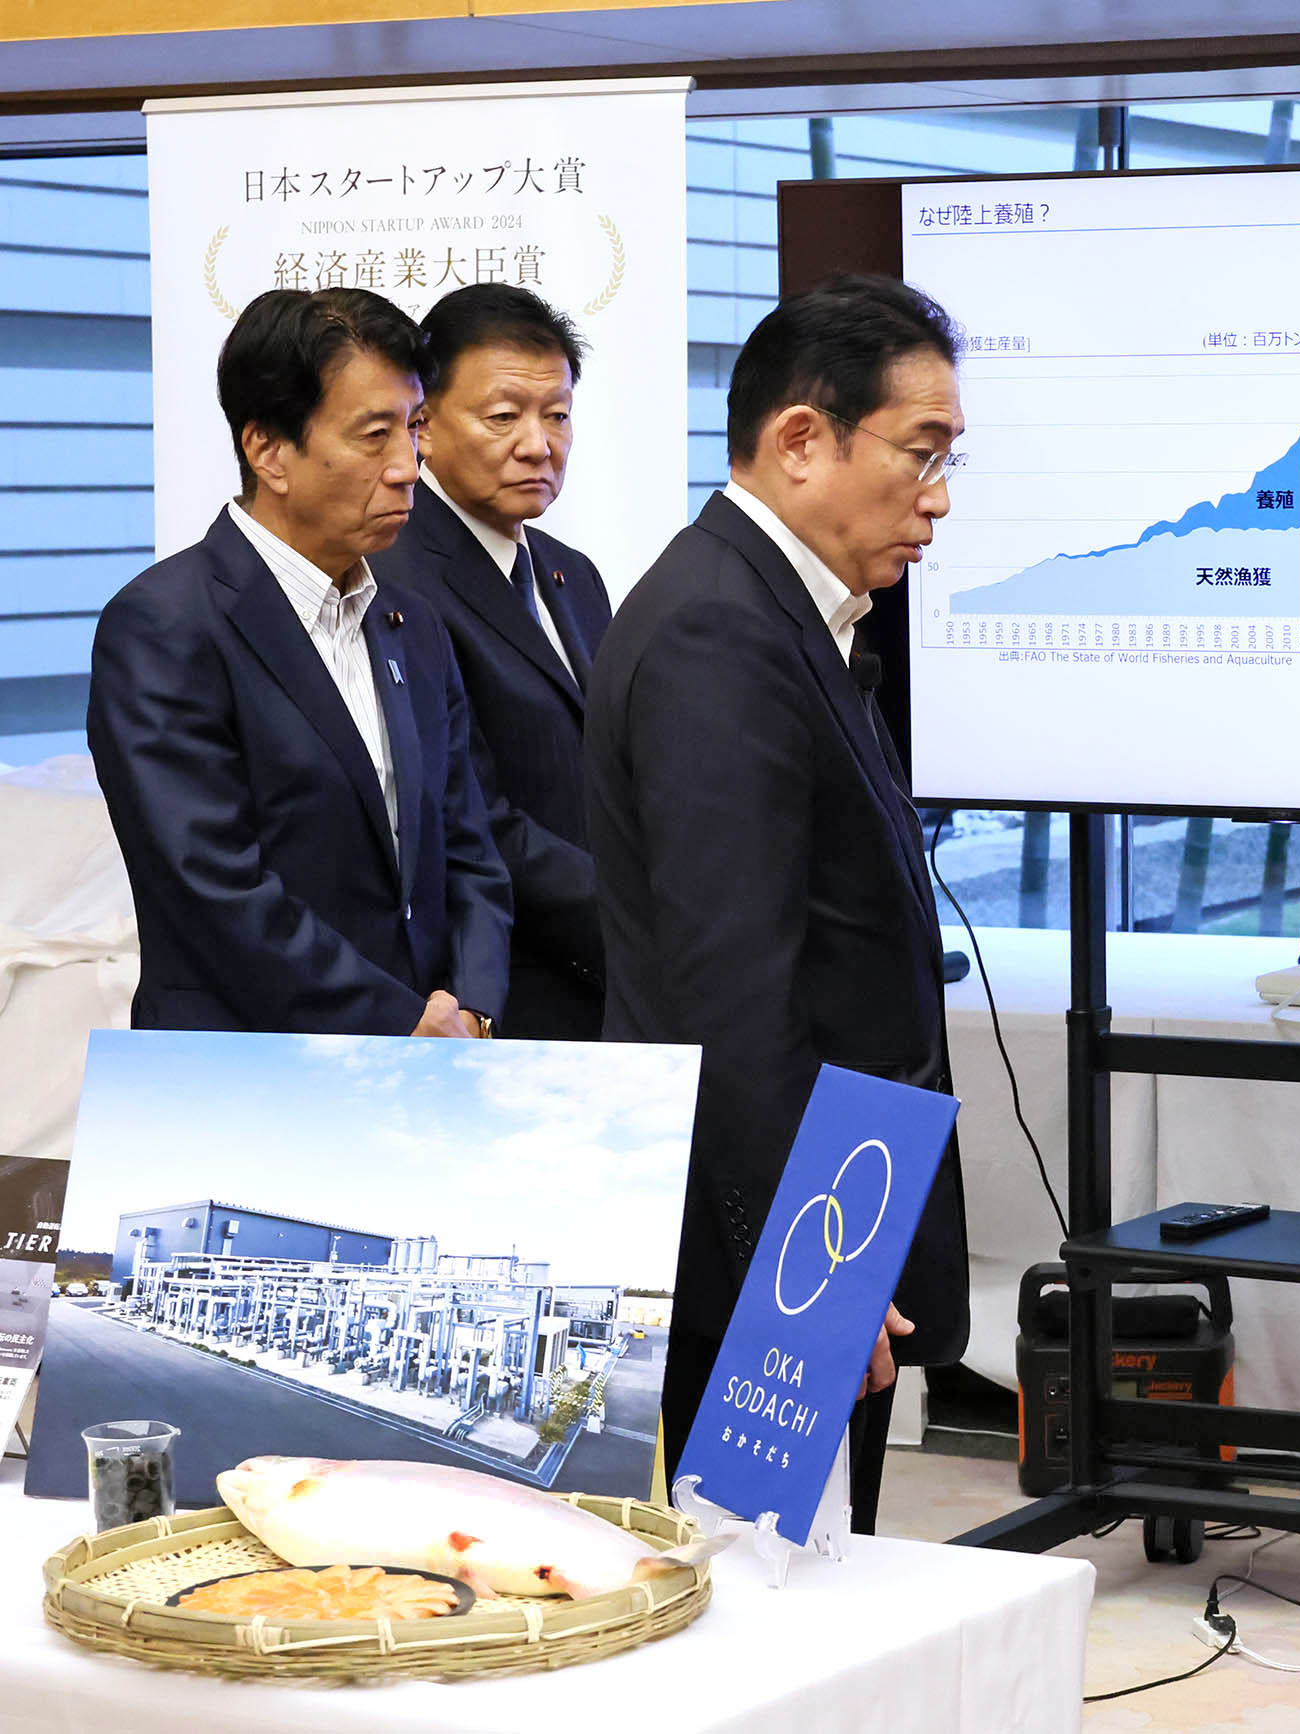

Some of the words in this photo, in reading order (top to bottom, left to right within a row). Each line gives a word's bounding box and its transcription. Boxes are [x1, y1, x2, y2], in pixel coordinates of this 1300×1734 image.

[244, 157, 586, 202] 日本スタートアップ大賞
[301, 219, 355, 235] NIPPON
[361, 216, 424, 233] STARTUP
[430, 215, 484, 231] AWARD
[491, 213, 523, 230] 2024
[919, 203, 1050, 226] なぜ陸上養殖？
[273, 245, 547, 292] 経済産業大臣賞
[1256, 490, 1295, 509] 養殖
[927, 562, 939, 571] 50
[1196, 567, 1272, 586] 天然漁獲
[933, 609, 940, 618] 0
[979, 622, 987, 645] 1956
[1012, 622, 1020, 645] 1962
[1045, 622, 1053, 645] 1968
[1062, 624, 1070, 646] 1971
[1112, 623, 1120, 646] 1980
[1128, 624, 1136, 646] 1983
[1146, 624, 1154, 647] 1986
[1180, 624, 1188, 647] 1992
[1197, 624, 1205, 648] 1995
[1214, 624, 1222, 648] 1998
[1231, 626, 1239, 649] 2001
[1248, 625, 1256, 649] 2004
[1266, 625, 1274, 649] 2007
[1283, 625, 1291, 650] 2010
[1051, 651, 1069, 662] The
[1072, 652, 1100, 663] State
[1104, 652, 1115, 663] of
[1118, 653, 1148, 664] World
[1152, 653, 1200, 665] Fisheries
[1203, 653, 1223, 665] and
[1227, 654, 1293, 667] Aquaculture
[763, 1347, 804, 1388] OKA
[723, 1374, 819, 1438] SODACHI
[721, 1425, 791, 1469] おかそだち
